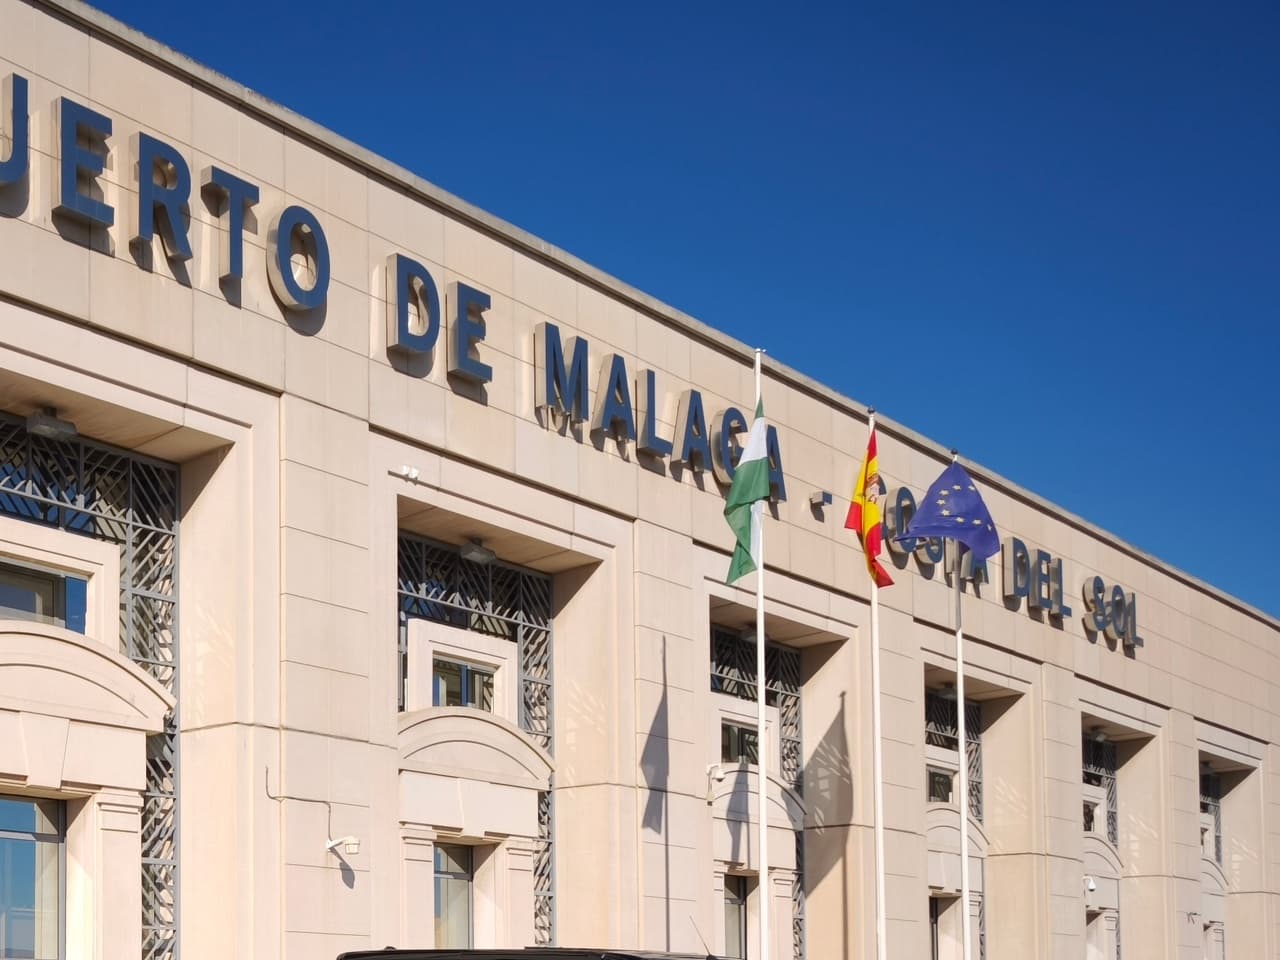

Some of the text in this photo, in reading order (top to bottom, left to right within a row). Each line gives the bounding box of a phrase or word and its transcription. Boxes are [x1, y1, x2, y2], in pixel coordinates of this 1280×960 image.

[386, 253, 493, 384] DE
[1004, 537, 1072, 617] DEL
[1083, 575, 1144, 648] SOL
